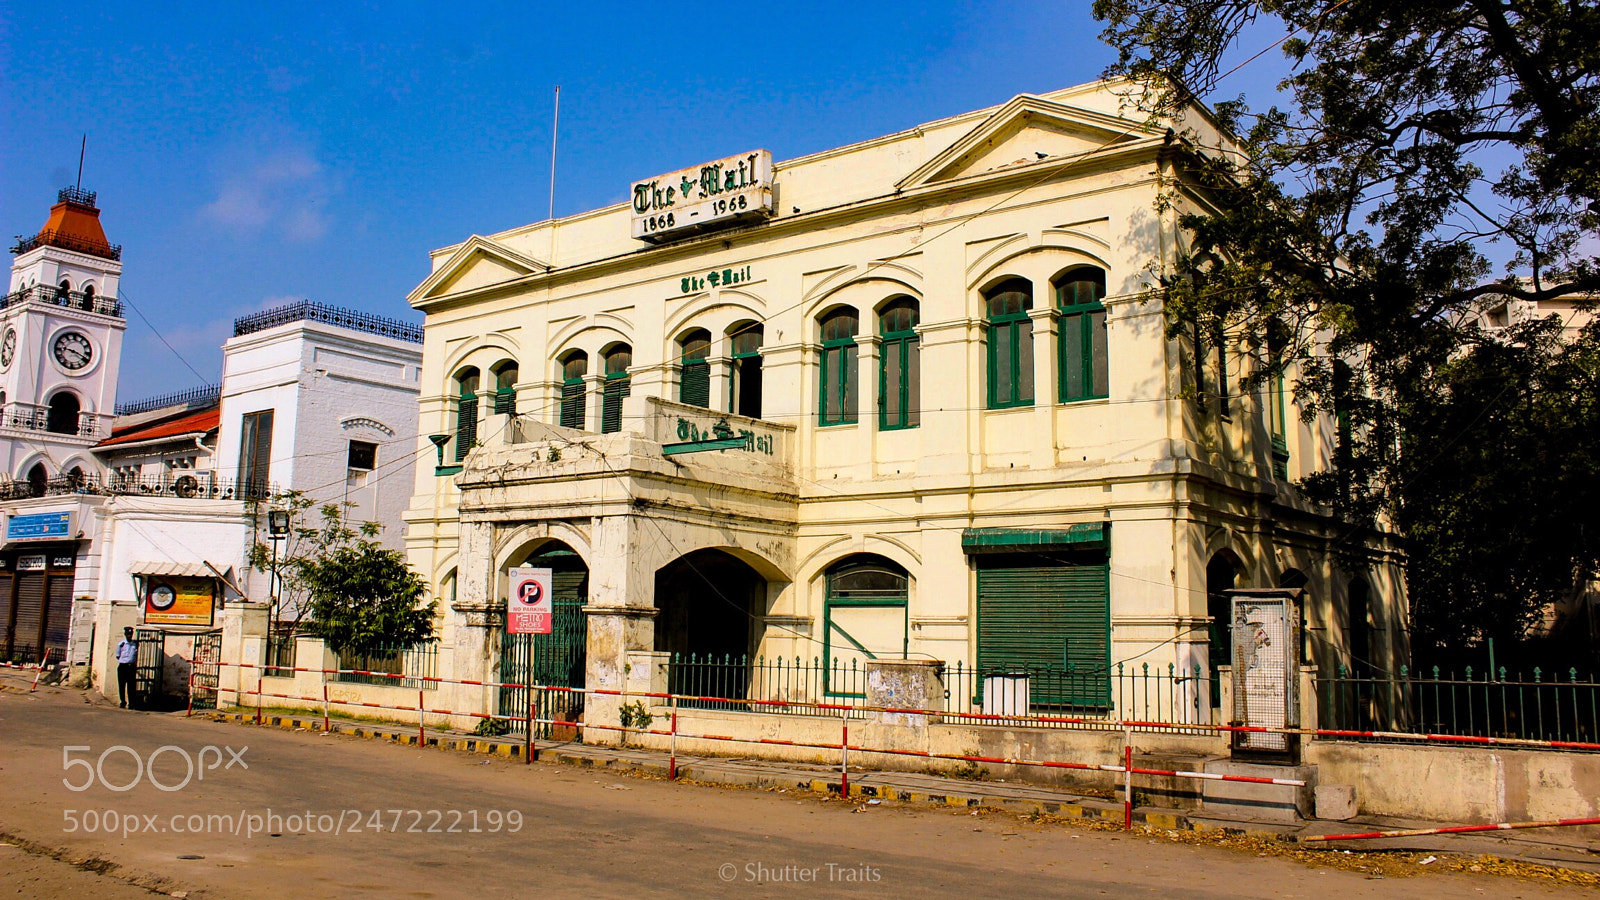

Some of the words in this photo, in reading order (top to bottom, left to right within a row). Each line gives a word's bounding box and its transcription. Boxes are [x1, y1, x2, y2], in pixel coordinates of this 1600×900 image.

[633, 180, 676, 214] The
[699, 153, 759, 199] Mail
[643, 212, 675, 233] 1868
[713, 194, 748, 216] 1968
[681, 276, 704, 293] The
[722, 265, 751, 286] Mail
[53, 557, 72, 566] CASIO
[516, 614, 543, 622] METRO
